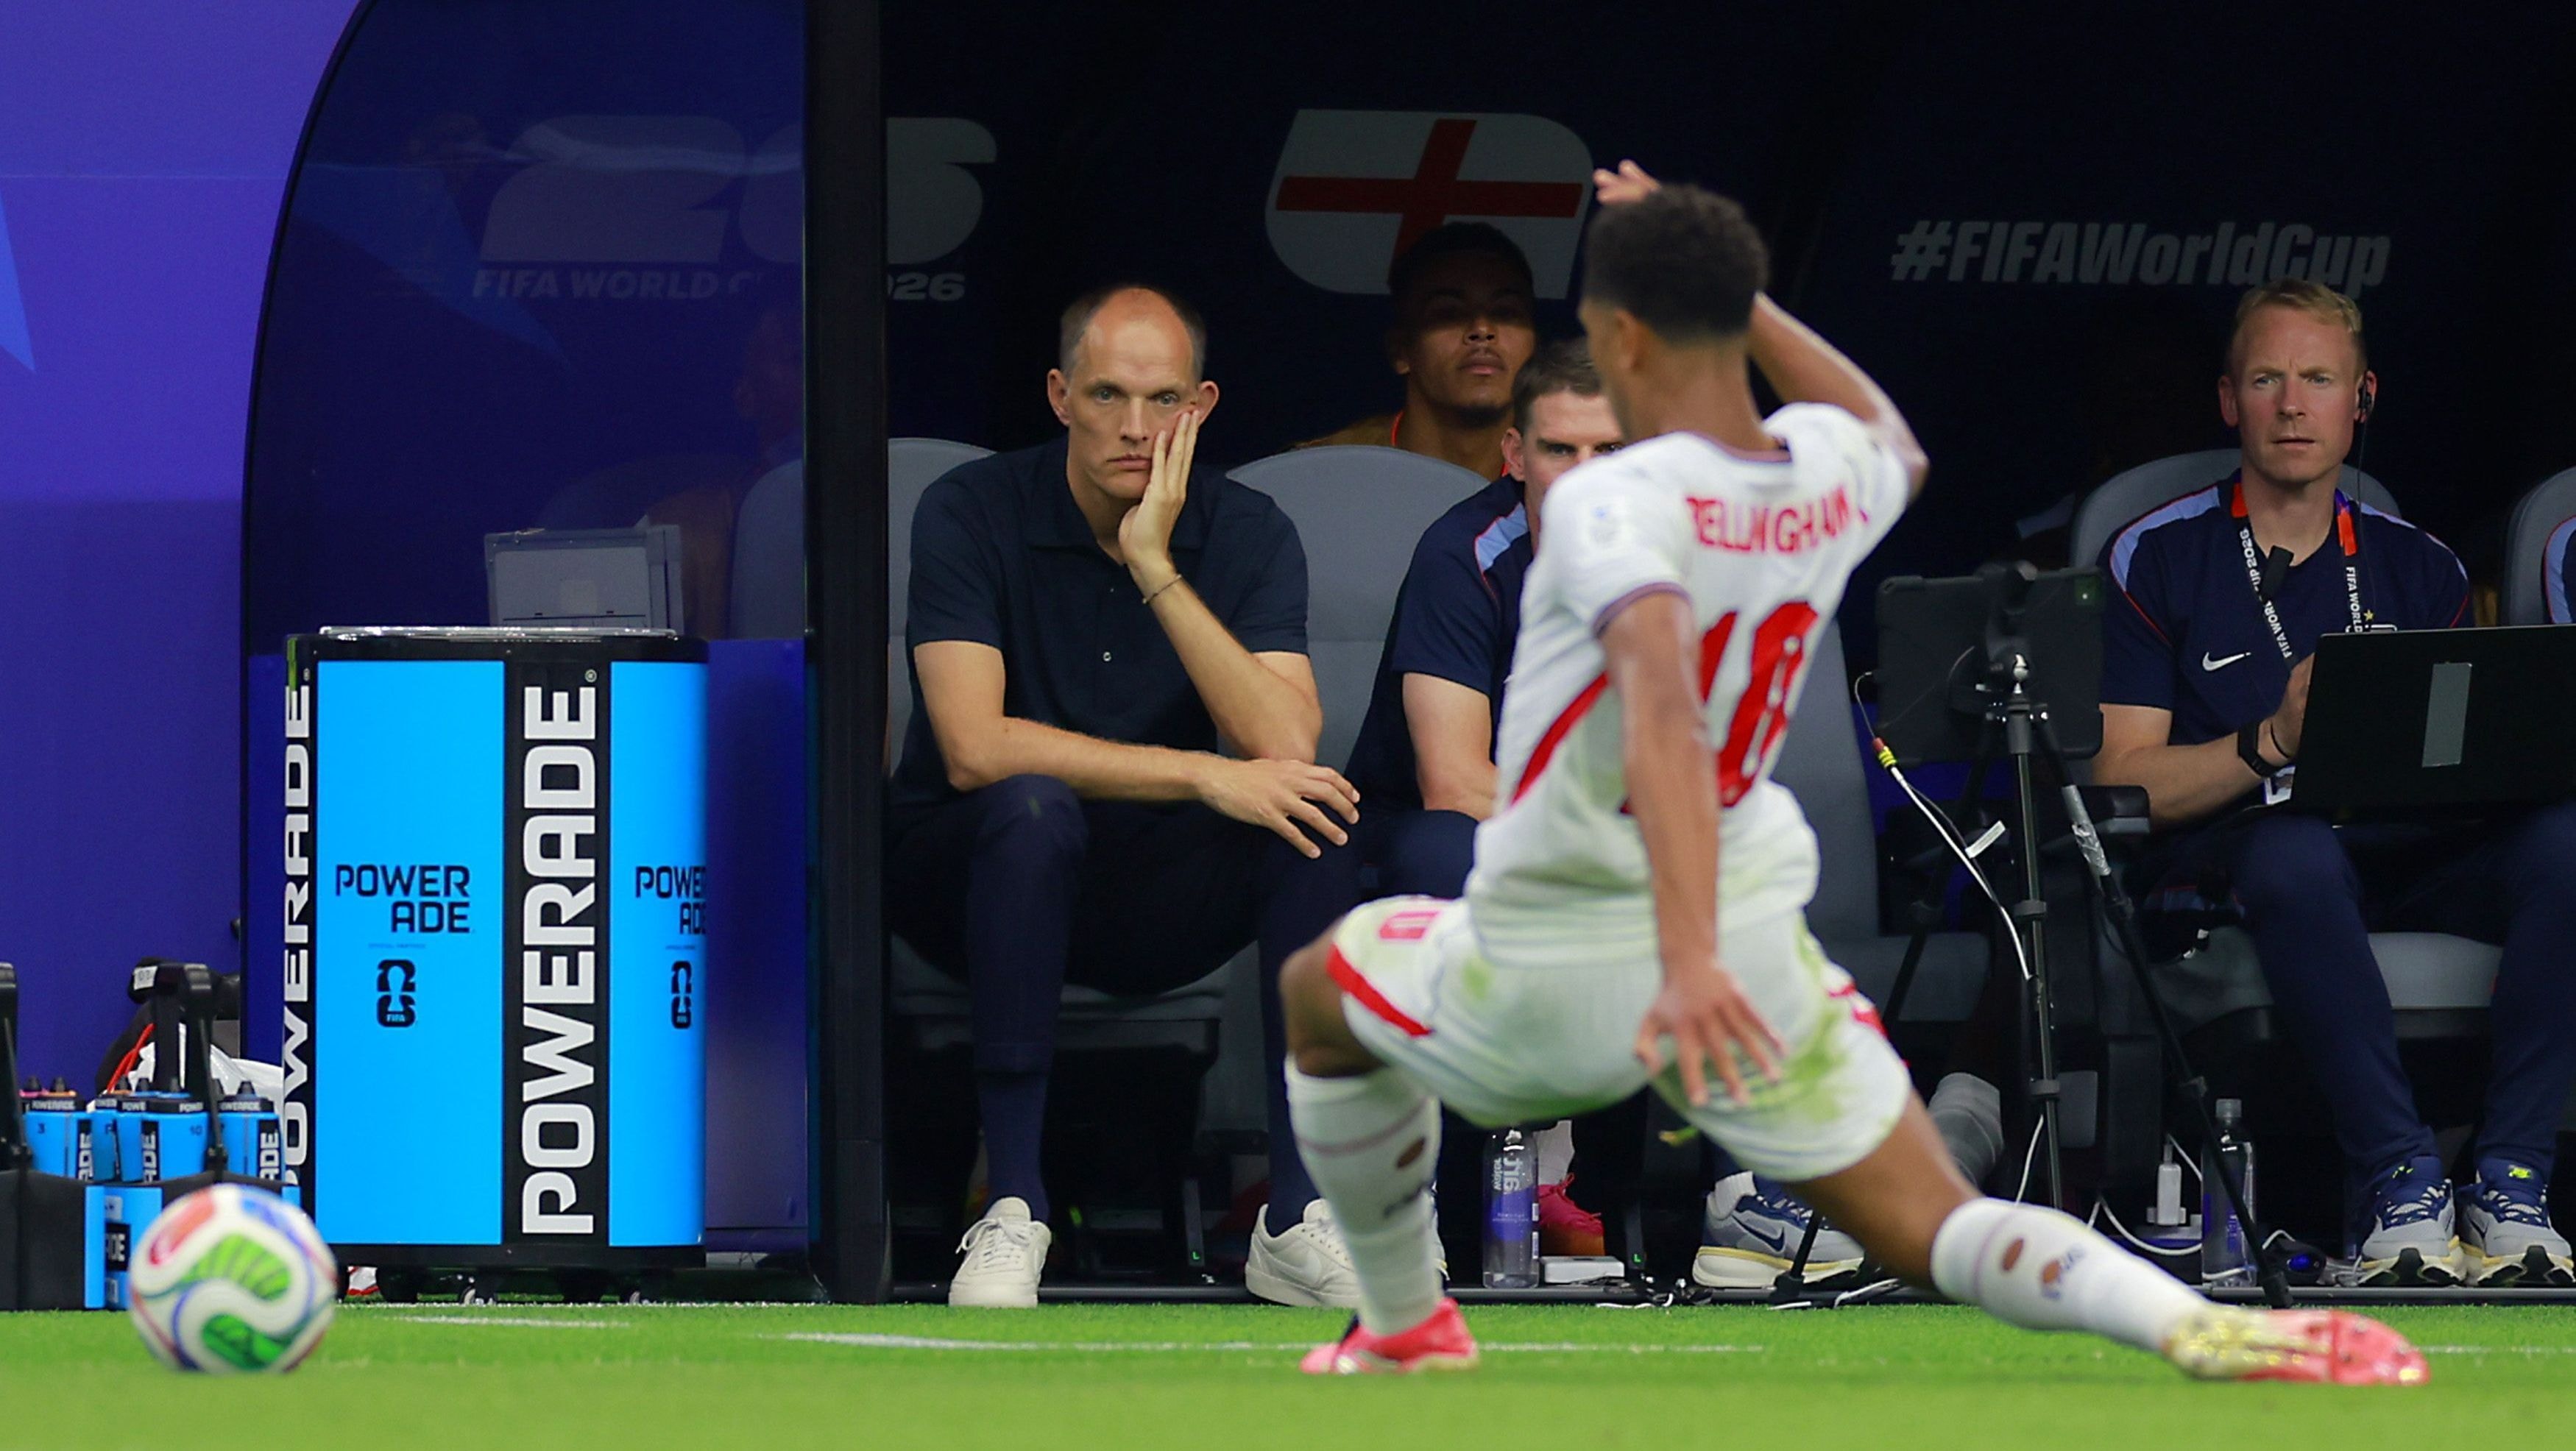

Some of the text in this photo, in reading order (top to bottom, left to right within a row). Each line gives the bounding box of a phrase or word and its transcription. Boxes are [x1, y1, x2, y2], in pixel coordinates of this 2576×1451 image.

[1891, 219, 2391, 299] #FIFAWorldCup
[473, 269, 559, 300] FIFA
[570, 269, 720, 301] WORLD
[885, 273, 966, 302] 26
[2240, 527, 2258, 568] 2026
[2260, 597, 2282, 635] WORL
[2346, 566, 2363, 633] FIFA WORLD
[2276, 631, 2293, 659] FIFA
[335, 863, 471, 898] POWER
[390, 900, 471, 934] ADE
[523, 685, 596, 1235] POWERADE
[386, 1013, 406, 1022] FIFA
[1633, 1253, 1641, 1263] L
